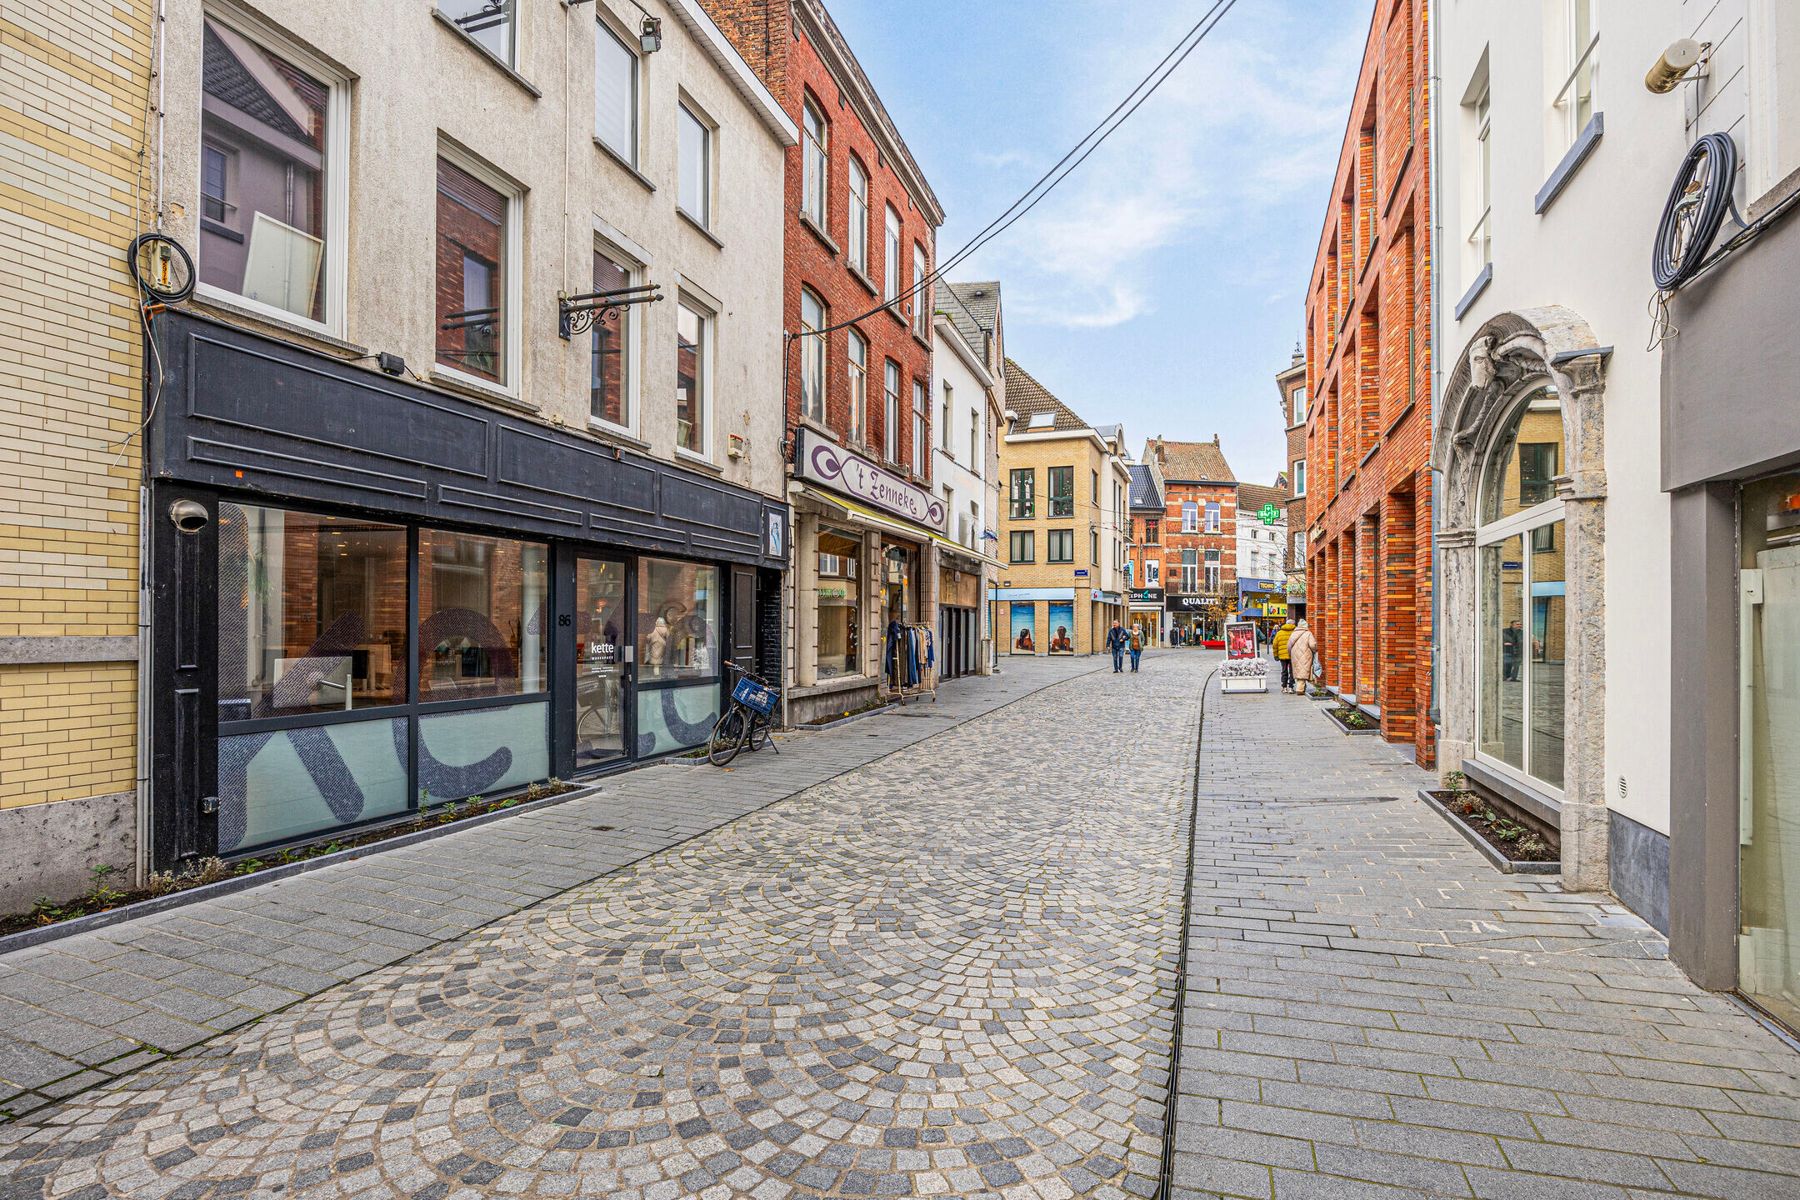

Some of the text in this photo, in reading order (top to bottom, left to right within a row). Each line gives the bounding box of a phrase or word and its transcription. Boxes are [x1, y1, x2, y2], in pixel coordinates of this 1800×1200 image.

[856, 463, 917, 515] 't Zenneke
[1182, 597, 1219, 606] QUALIT
[558, 614, 572, 627] 86
[591, 641, 614, 654] kette
